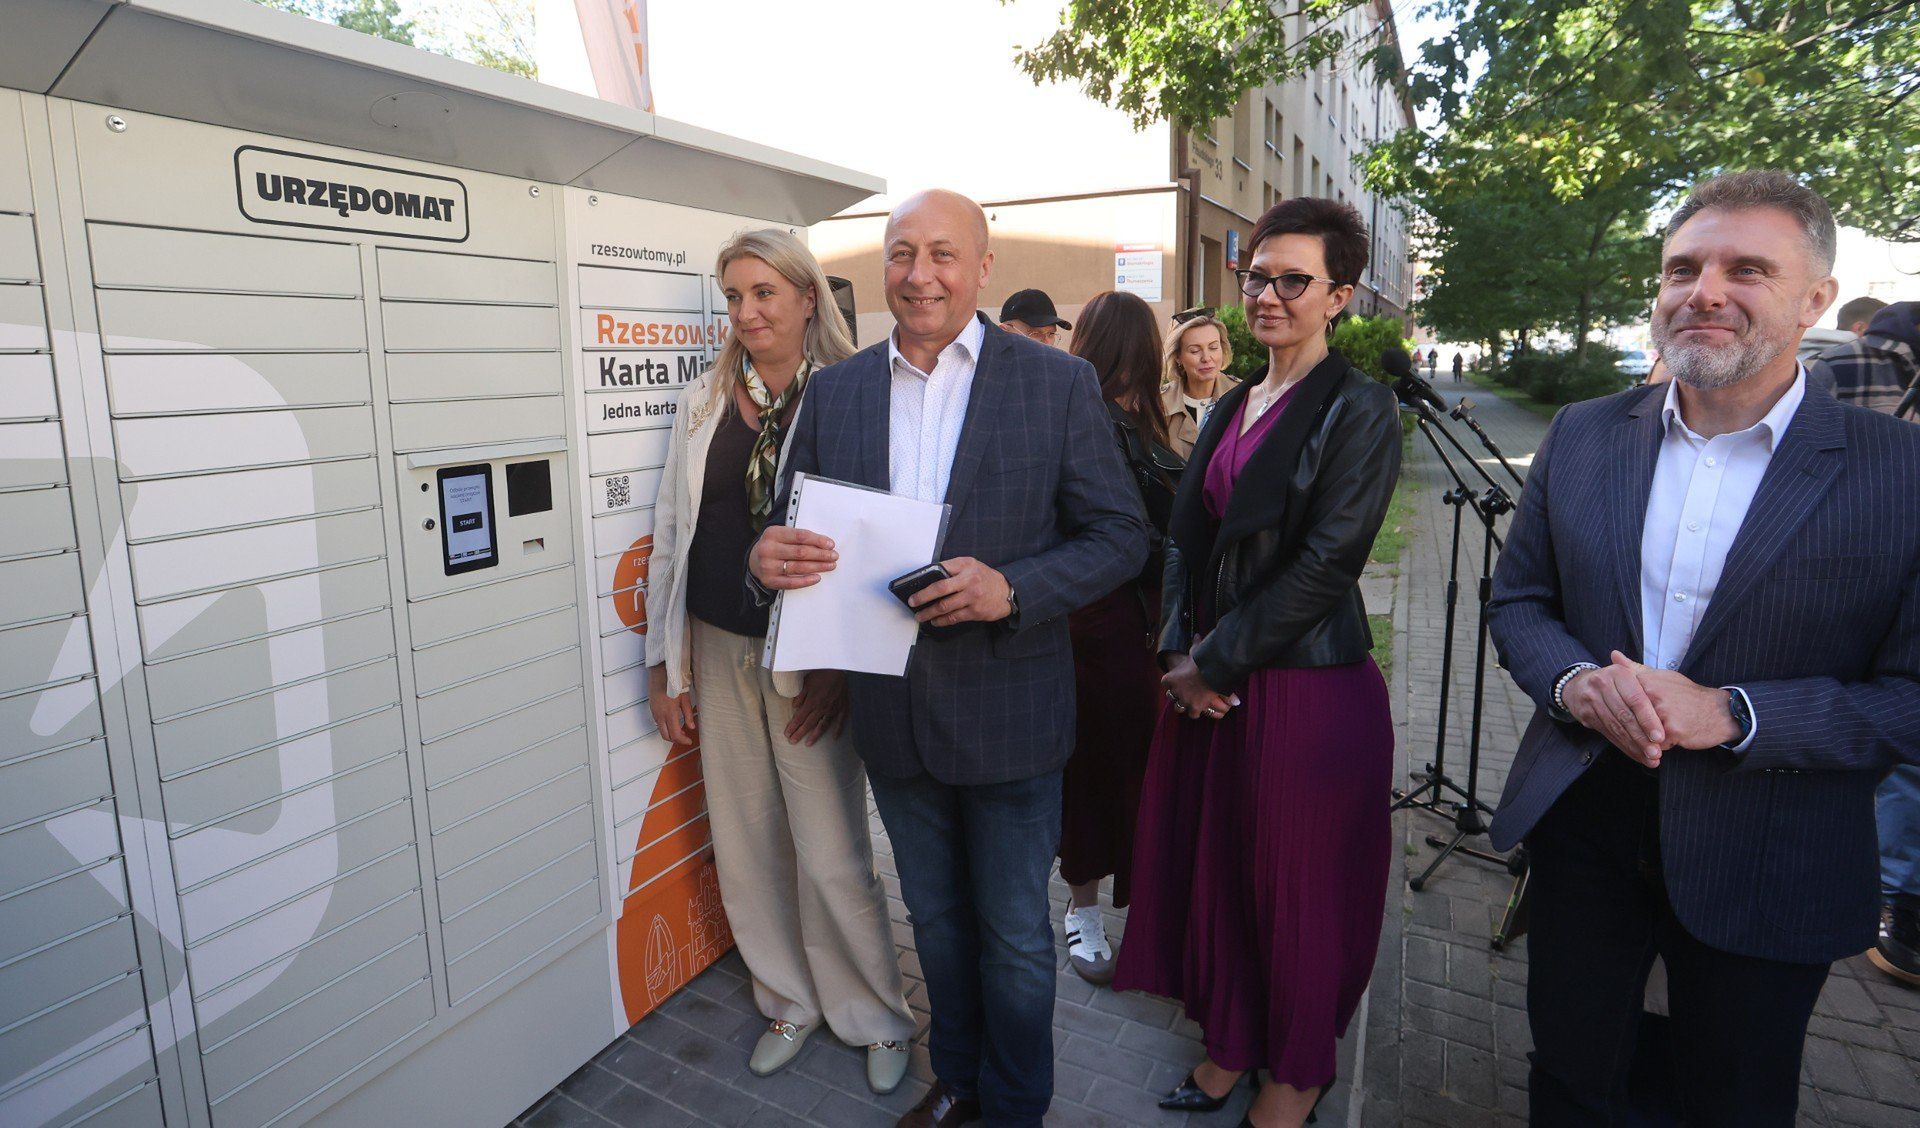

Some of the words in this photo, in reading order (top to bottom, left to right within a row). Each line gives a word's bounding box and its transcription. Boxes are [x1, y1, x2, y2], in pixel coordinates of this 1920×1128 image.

[256, 172, 455, 222] URZĘDOMAT
[591, 243, 686, 267] rzeszowtomy.pl
[600, 356, 670, 387] Karta
[602, 402, 642, 421] Jedna
[645, 401, 677, 417] karta
[459, 518, 476, 527] START
